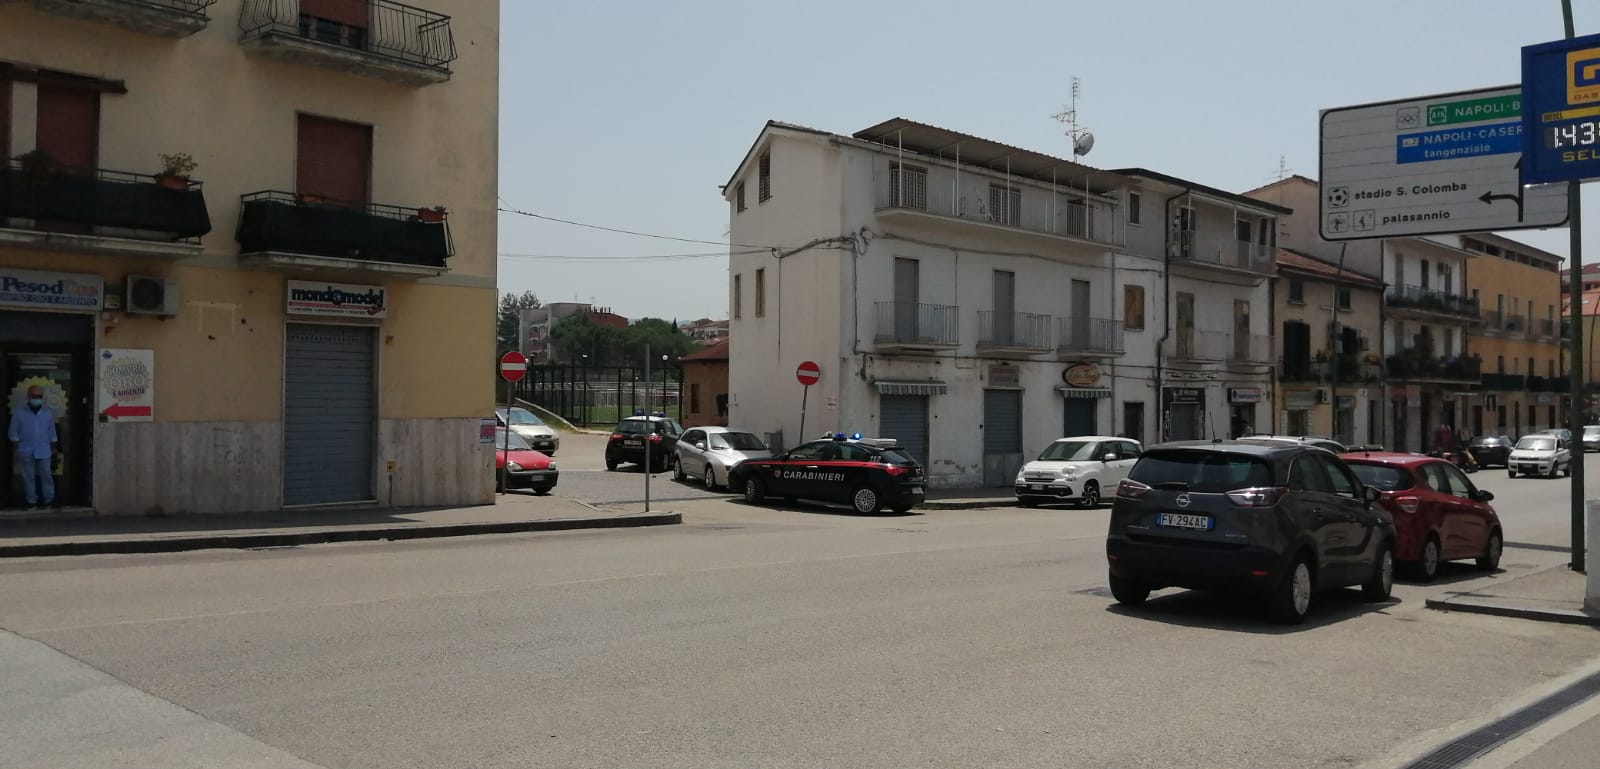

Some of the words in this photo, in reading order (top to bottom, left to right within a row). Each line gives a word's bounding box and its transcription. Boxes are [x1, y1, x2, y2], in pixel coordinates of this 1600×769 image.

[1424, 144, 1491, 158] tangenziale
[1355, 188, 1392, 200] stadio
[1396, 186, 1408, 197] S.
[1412, 182, 1467, 195] Colomba
[1383, 211, 1450, 225] palasannio
[783, 470, 845, 482] CARABINIERI
